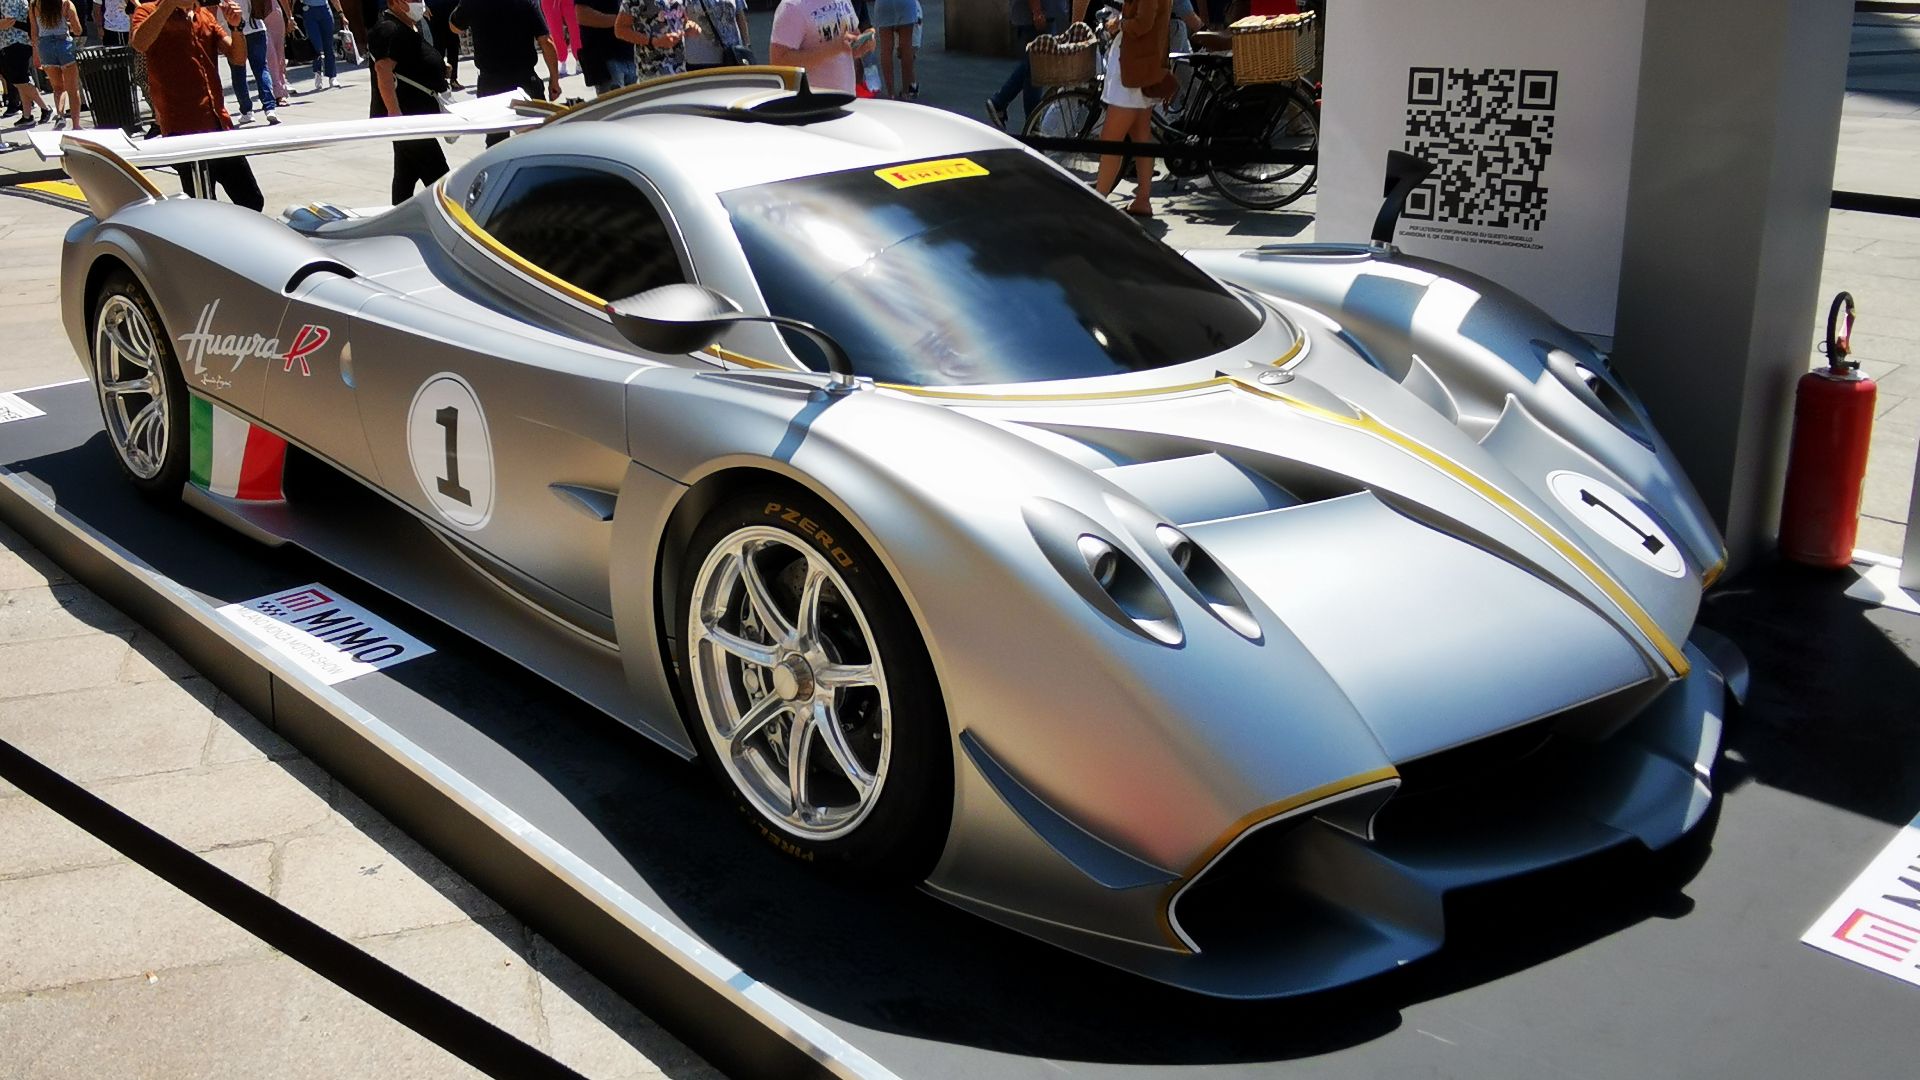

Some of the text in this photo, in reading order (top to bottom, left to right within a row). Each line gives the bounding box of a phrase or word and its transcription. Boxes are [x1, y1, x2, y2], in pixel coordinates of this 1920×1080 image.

[1488, 232, 1507, 240] QUESTO
[178, 298, 281, 375] Huayra
[436, 406, 472, 507] 1
[1580, 489, 1665, 555] 1
[291, 608, 405, 664] MIMO
